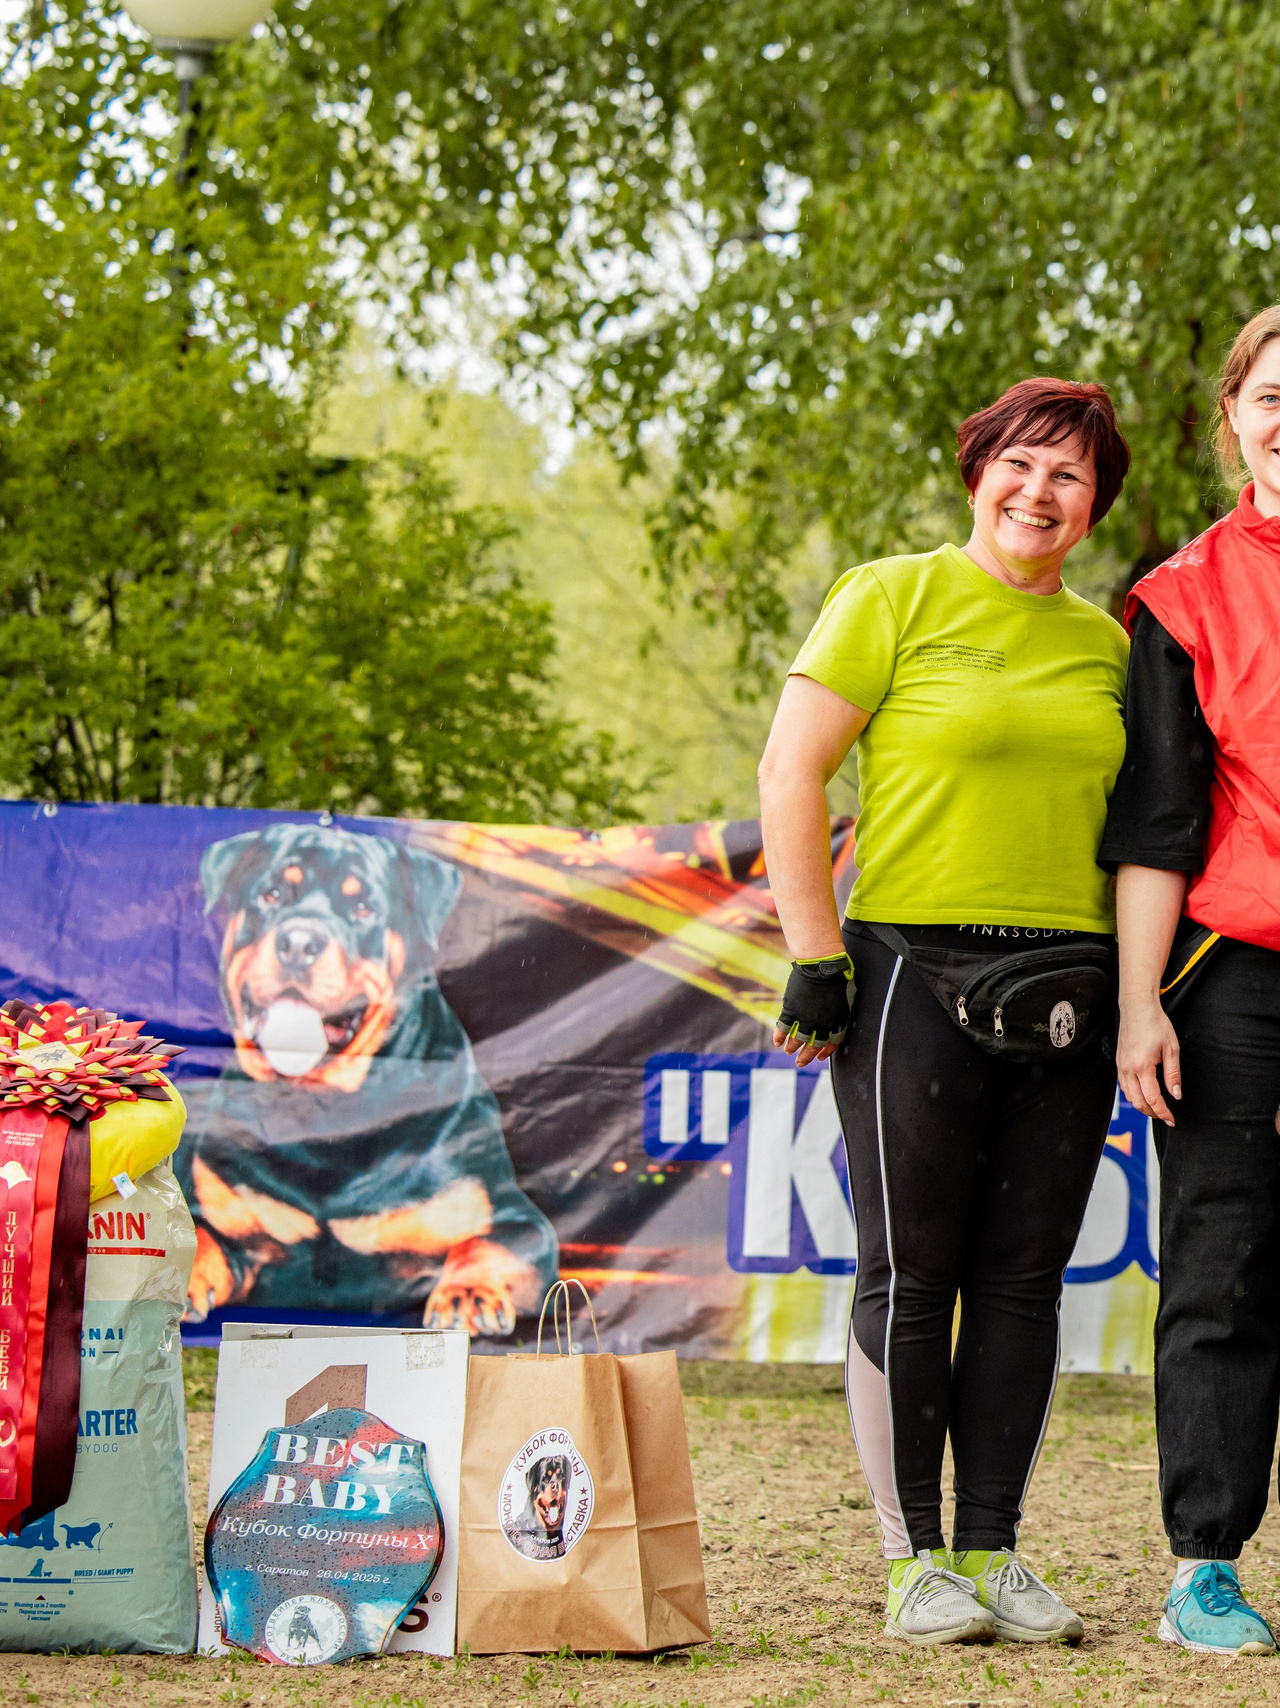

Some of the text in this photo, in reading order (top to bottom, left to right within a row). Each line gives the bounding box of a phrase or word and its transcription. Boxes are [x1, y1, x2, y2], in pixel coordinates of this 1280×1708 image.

[959, 924, 1075, 938] PINKSODA
[1, 1211, 18, 1306] ЛУЧШИЙ
[270, 1433, 415, 1473] BEST
[514, 1434, 546, 1471] КУБОК
[261, 1474, 404, 1515] BABY
[221, 1516, 292, 1537] Кубок
[297, 1523, 409, 1550] Фортуны
[115, 1567, 134, 1575] PUPPY
[257, 1564, 309, 1577] Саратов
[316, 1569, 381, 1583] 26.04.2025
[310, 1596, 336, 1610] КЛУБ
